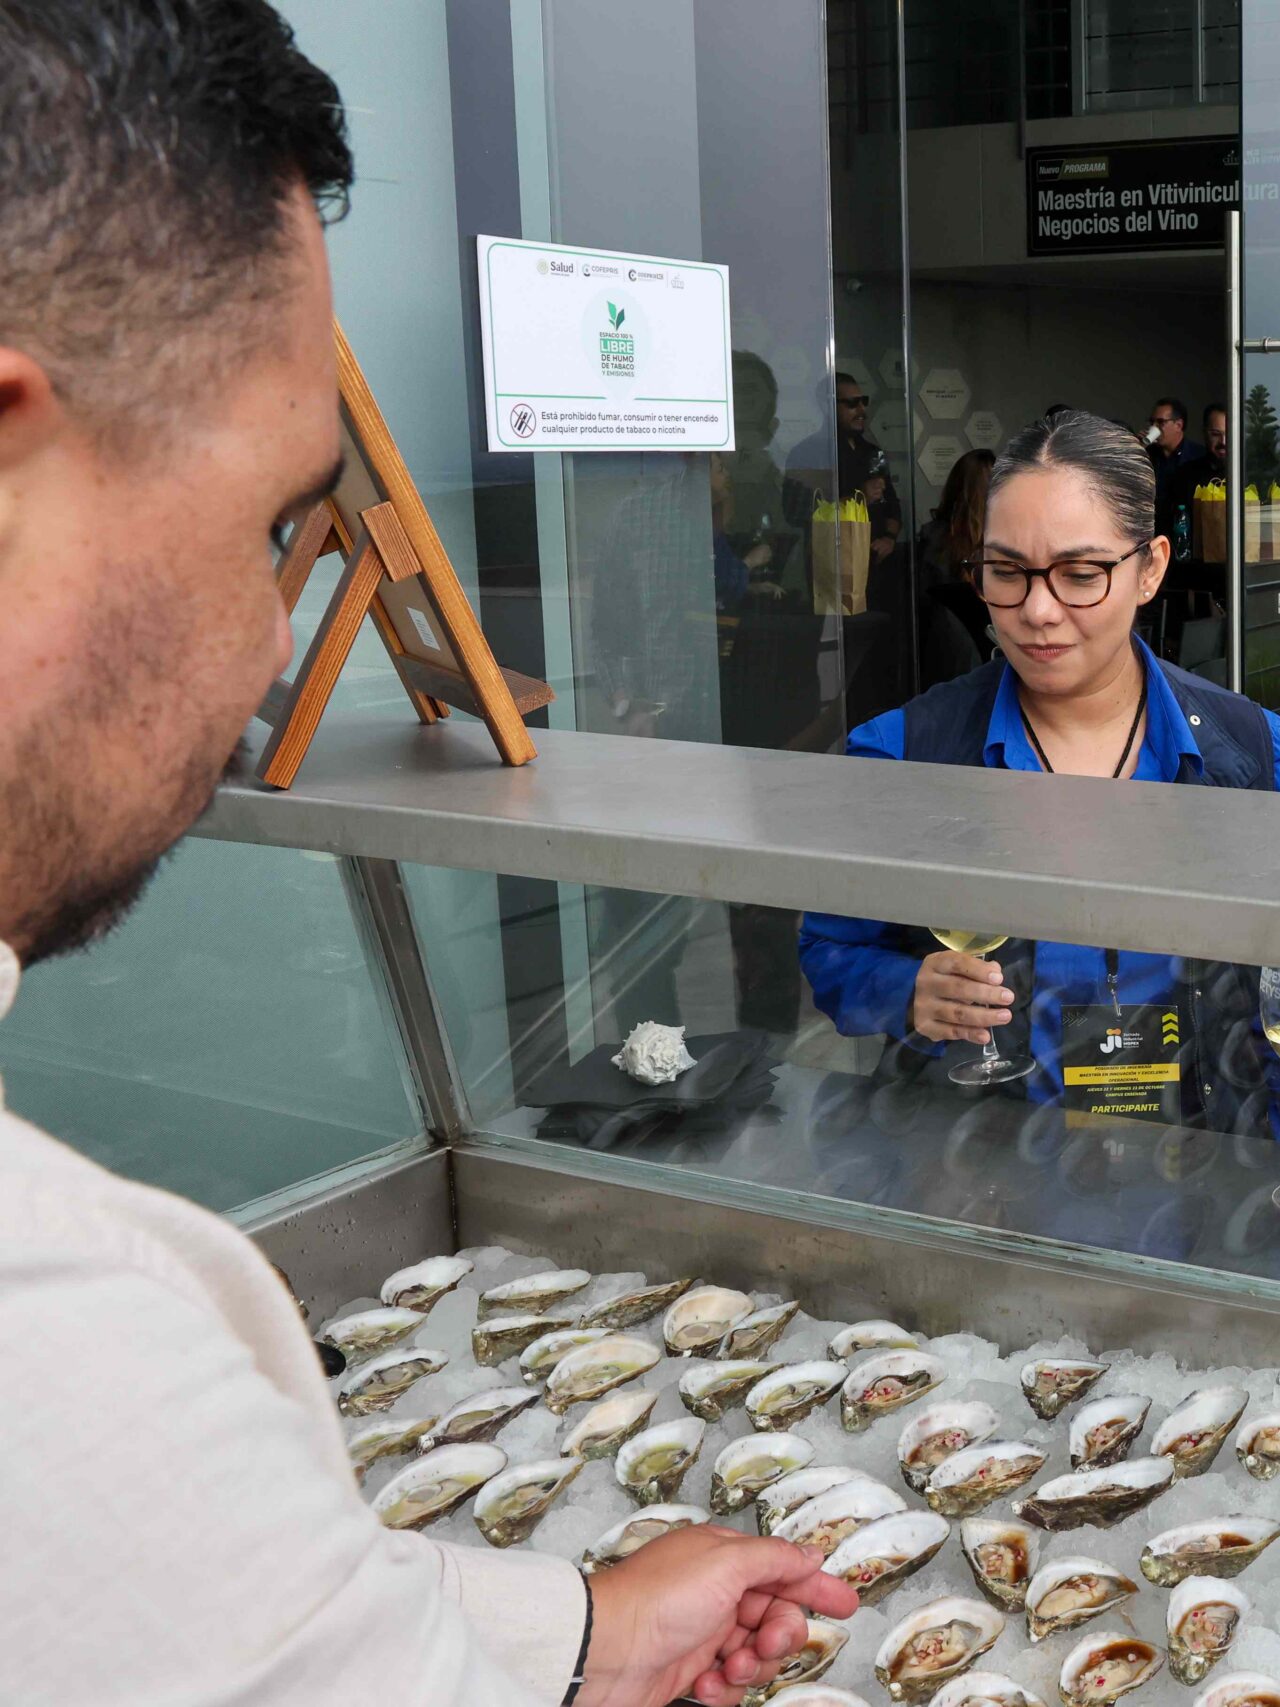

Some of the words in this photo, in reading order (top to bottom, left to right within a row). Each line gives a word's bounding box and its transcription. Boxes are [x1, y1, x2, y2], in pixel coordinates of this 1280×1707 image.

[1039, 165, 1060, 175] Nuevo
[1064, 162, 1106, 174] PROGRAMA
[1038, 187, 1115, 211] Maestría
[1120, 189, 1143, 207] en
[1148, 180, 1279, 206] Vitivinicultura
[1038, 213, 1120, 240] Negocios
[1125, 211, 1151, 232] del
[1157, 210, 1199, 231] Vino
[550, 261, 574, 274] Salud
[601, 340, 633, 353] LIBRE
[607, 370, 635, 378] EMISIONES
[542, 412, 558, 420] Está
[560, 412, 596, 423] prohibido
[598, 413, 622, 422] fumar,
[624, 414, 656, 422] consumir
[684, 414, 719, 423] encendido
[542, 425, 578, 435] cualquier
[580, 426, 614, 435] producto
[616, 426, 625, 434] de
[658, 426, 686, 434] nicotina
[1091, 1103, 1160, 1113] PARTICIPANTE
